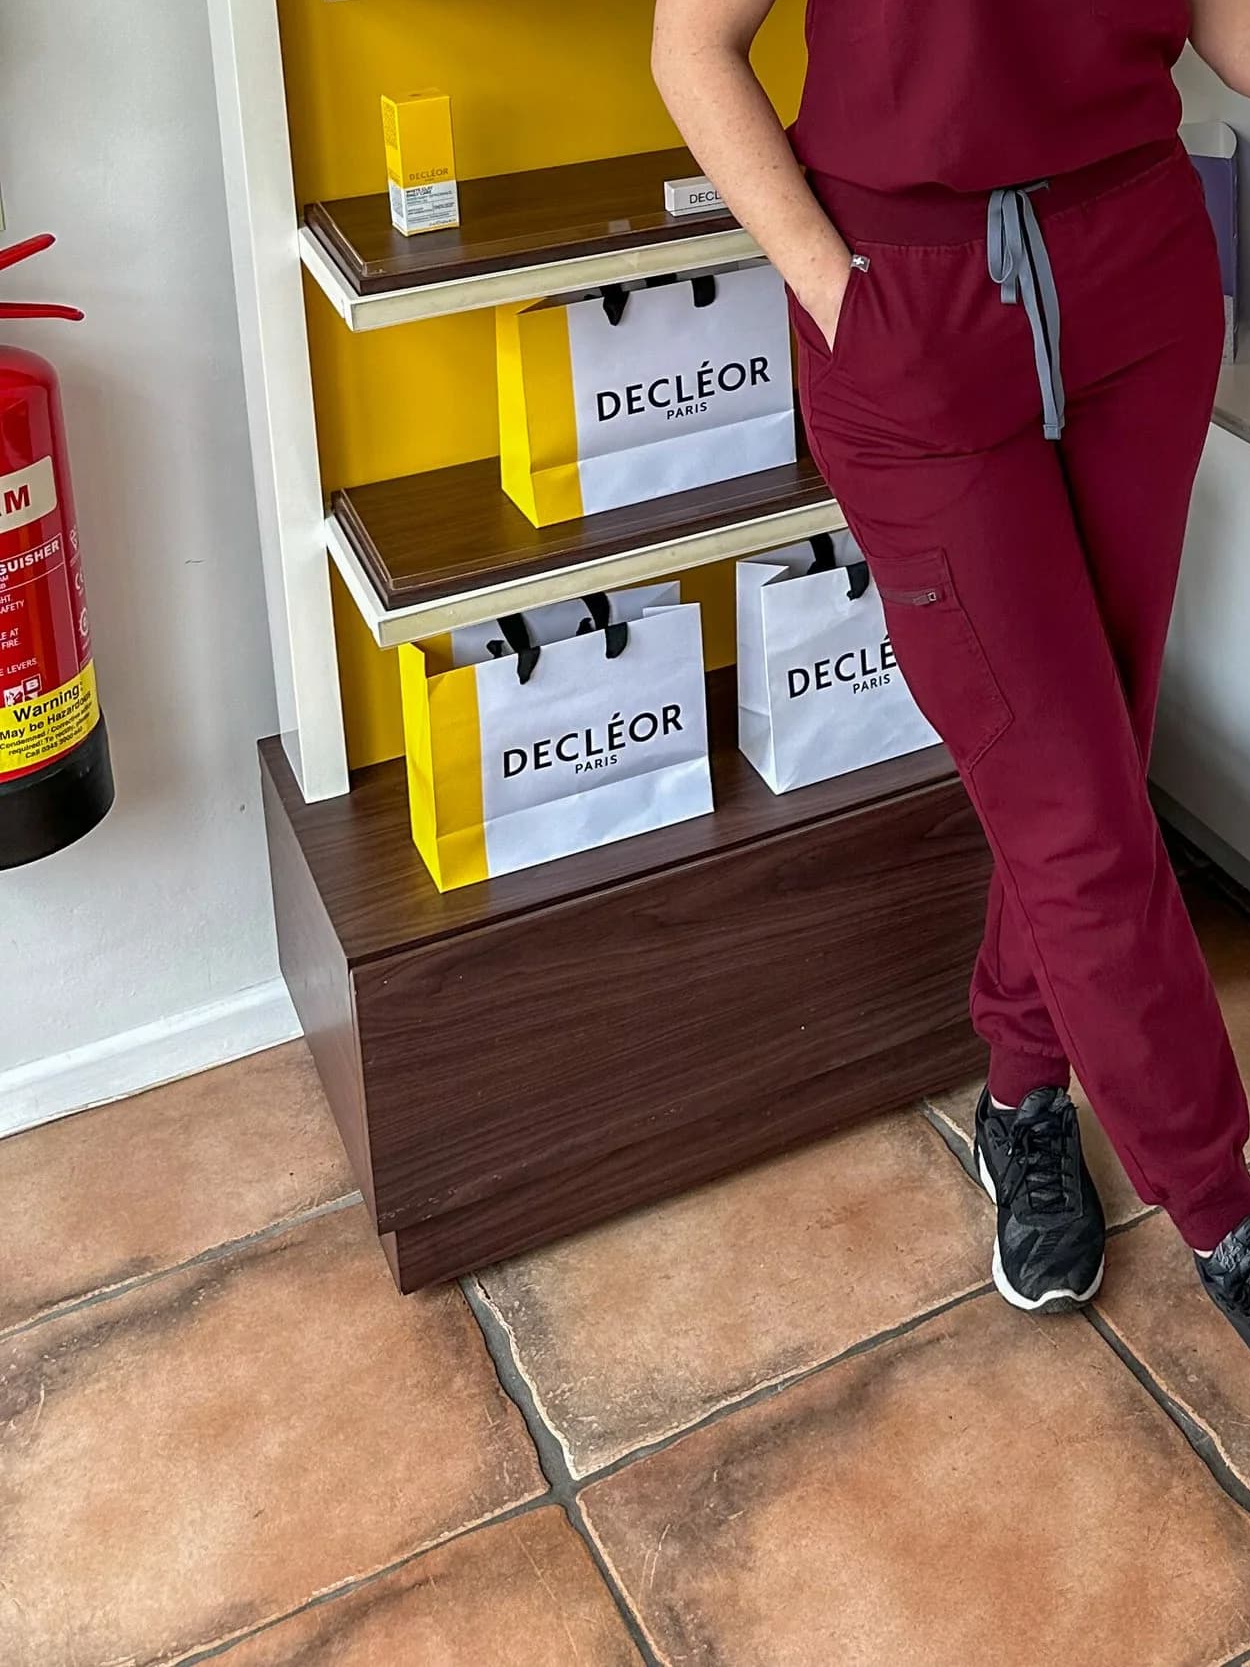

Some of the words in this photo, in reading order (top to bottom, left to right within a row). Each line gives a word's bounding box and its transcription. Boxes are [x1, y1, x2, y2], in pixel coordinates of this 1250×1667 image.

[408, 168, 449, 181] DECLÉOR
[689, 191, 722, 204] DECL
[596, 356, 771, 422] DECLÉOR
[666, 402, 708, 420] PARIS
[0, 484, 31, 517] M
[0, 599, 25, 614] AFETY
[788, 634, 896, 698] DECLÉ
[852, 674, 891, 694] PARIS
[0, 727, 25, 741] May
[29, 720, 44, 732] be
[503, 704, 683, 778] DECLÉOR
[575, 754, 618, 774] PARIS
